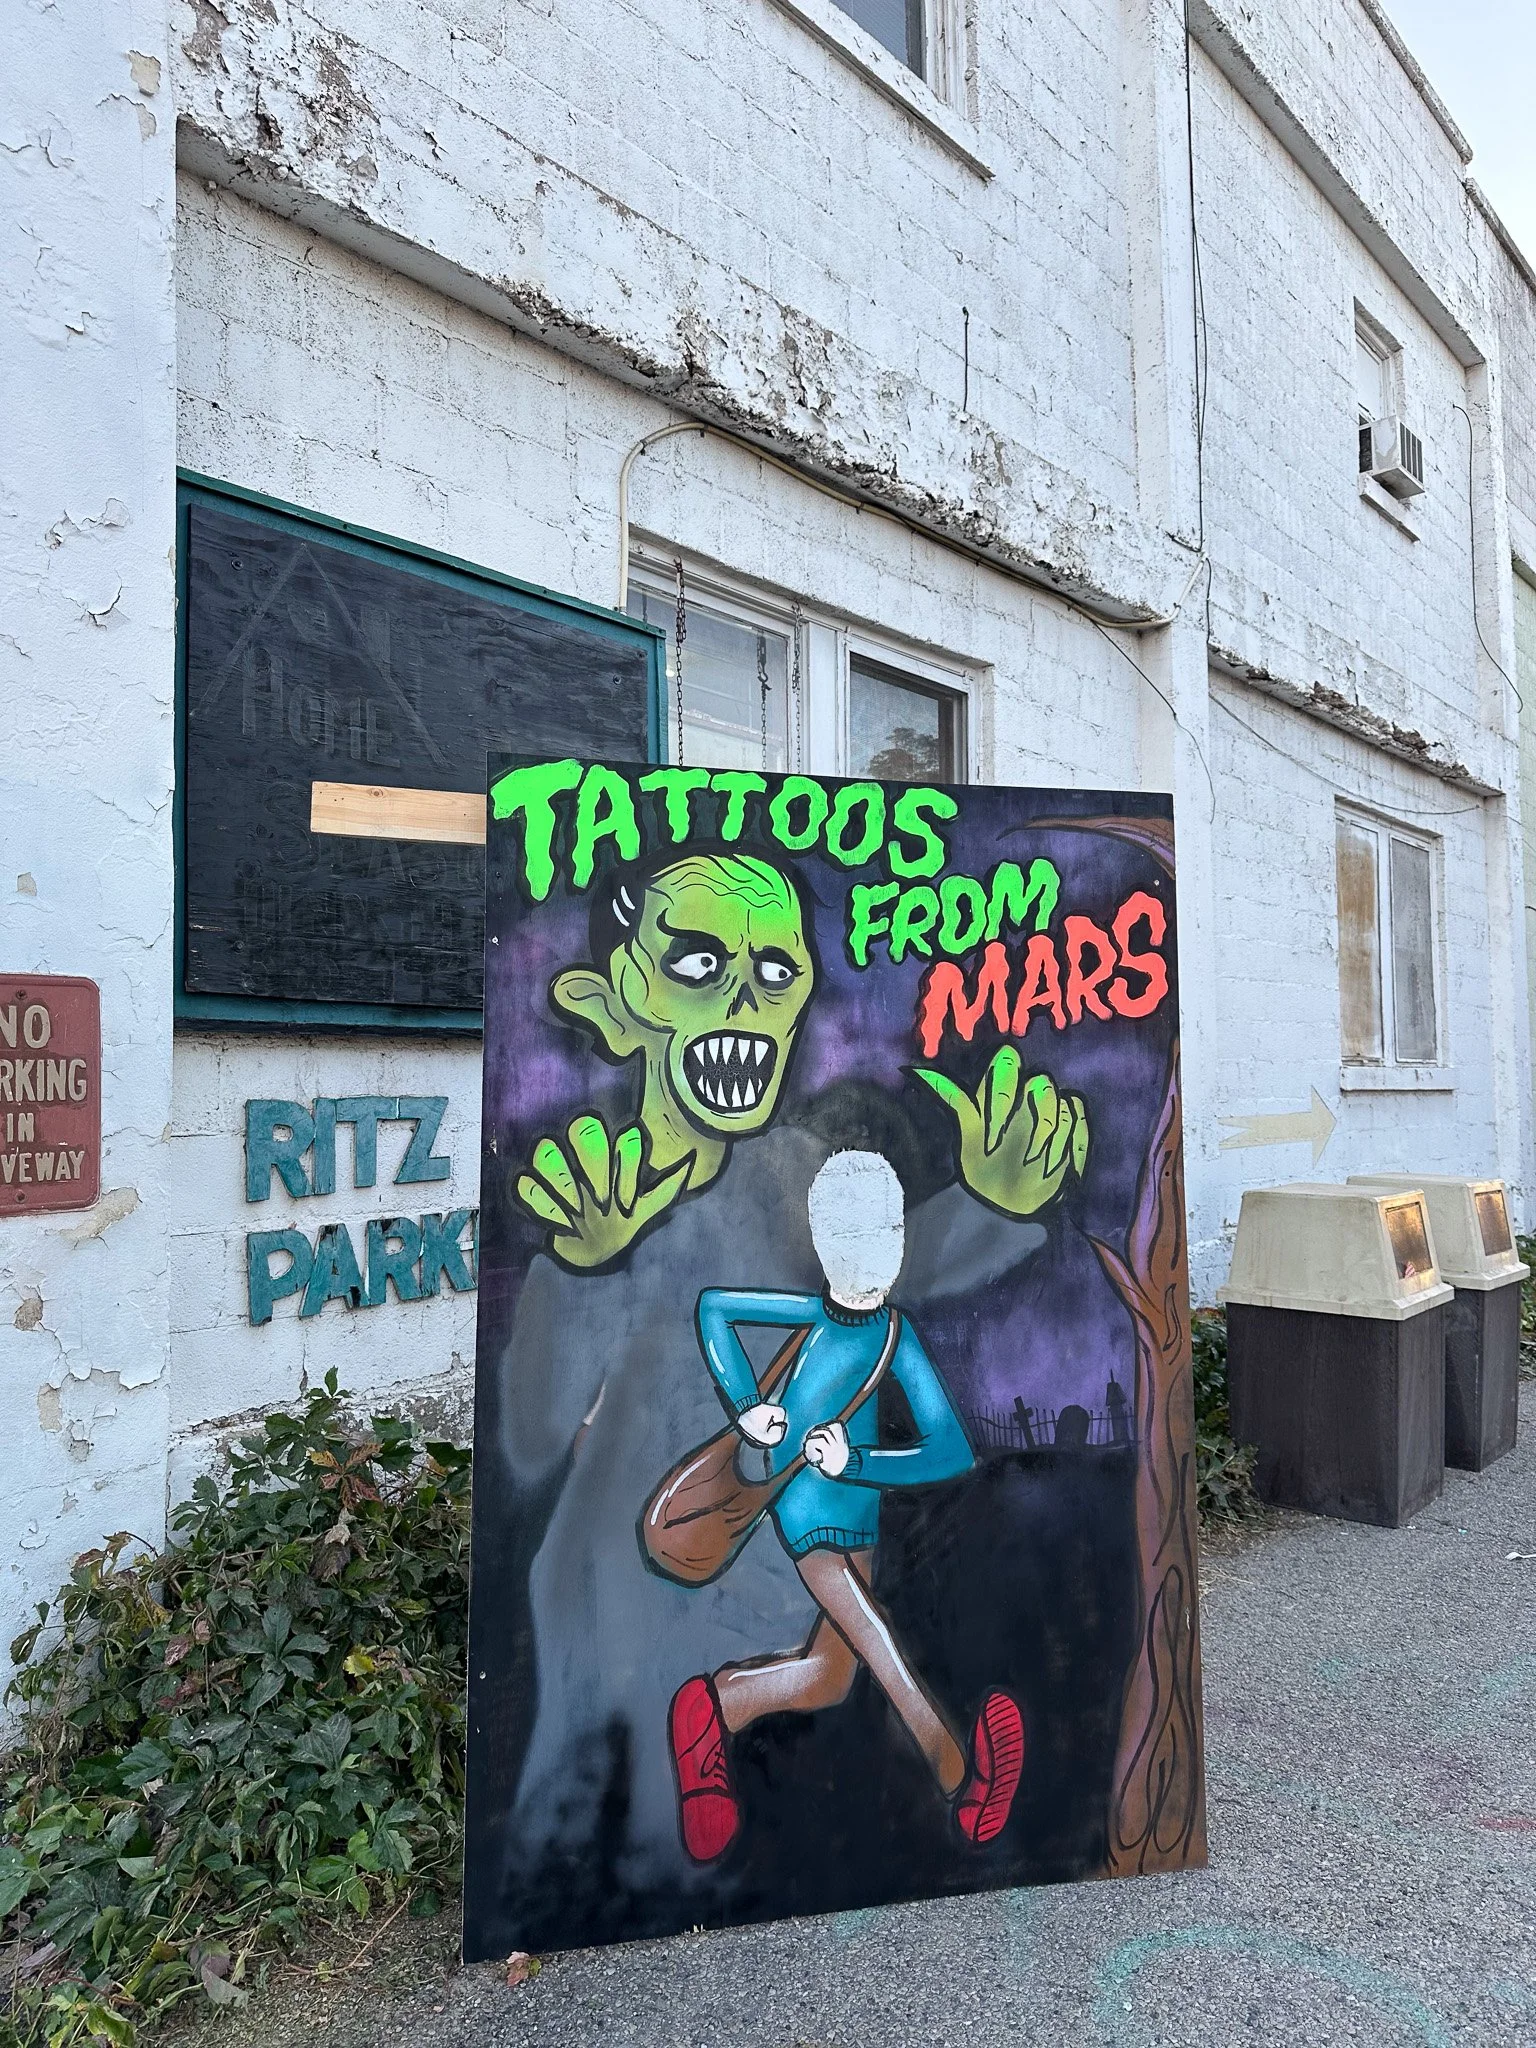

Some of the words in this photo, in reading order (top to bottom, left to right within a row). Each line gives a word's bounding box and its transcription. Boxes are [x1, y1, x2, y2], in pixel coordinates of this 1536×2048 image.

[491, 759, 958, 901] TATTOOS
[851, 858, 1060, 966] FROM
[919, 890, 1169, 1059] MARS
[6, 1112, 35, 1143] IN
[245, 1096, 451, 1203] RITZ
[246, 1208, 479, 1327] PARK
